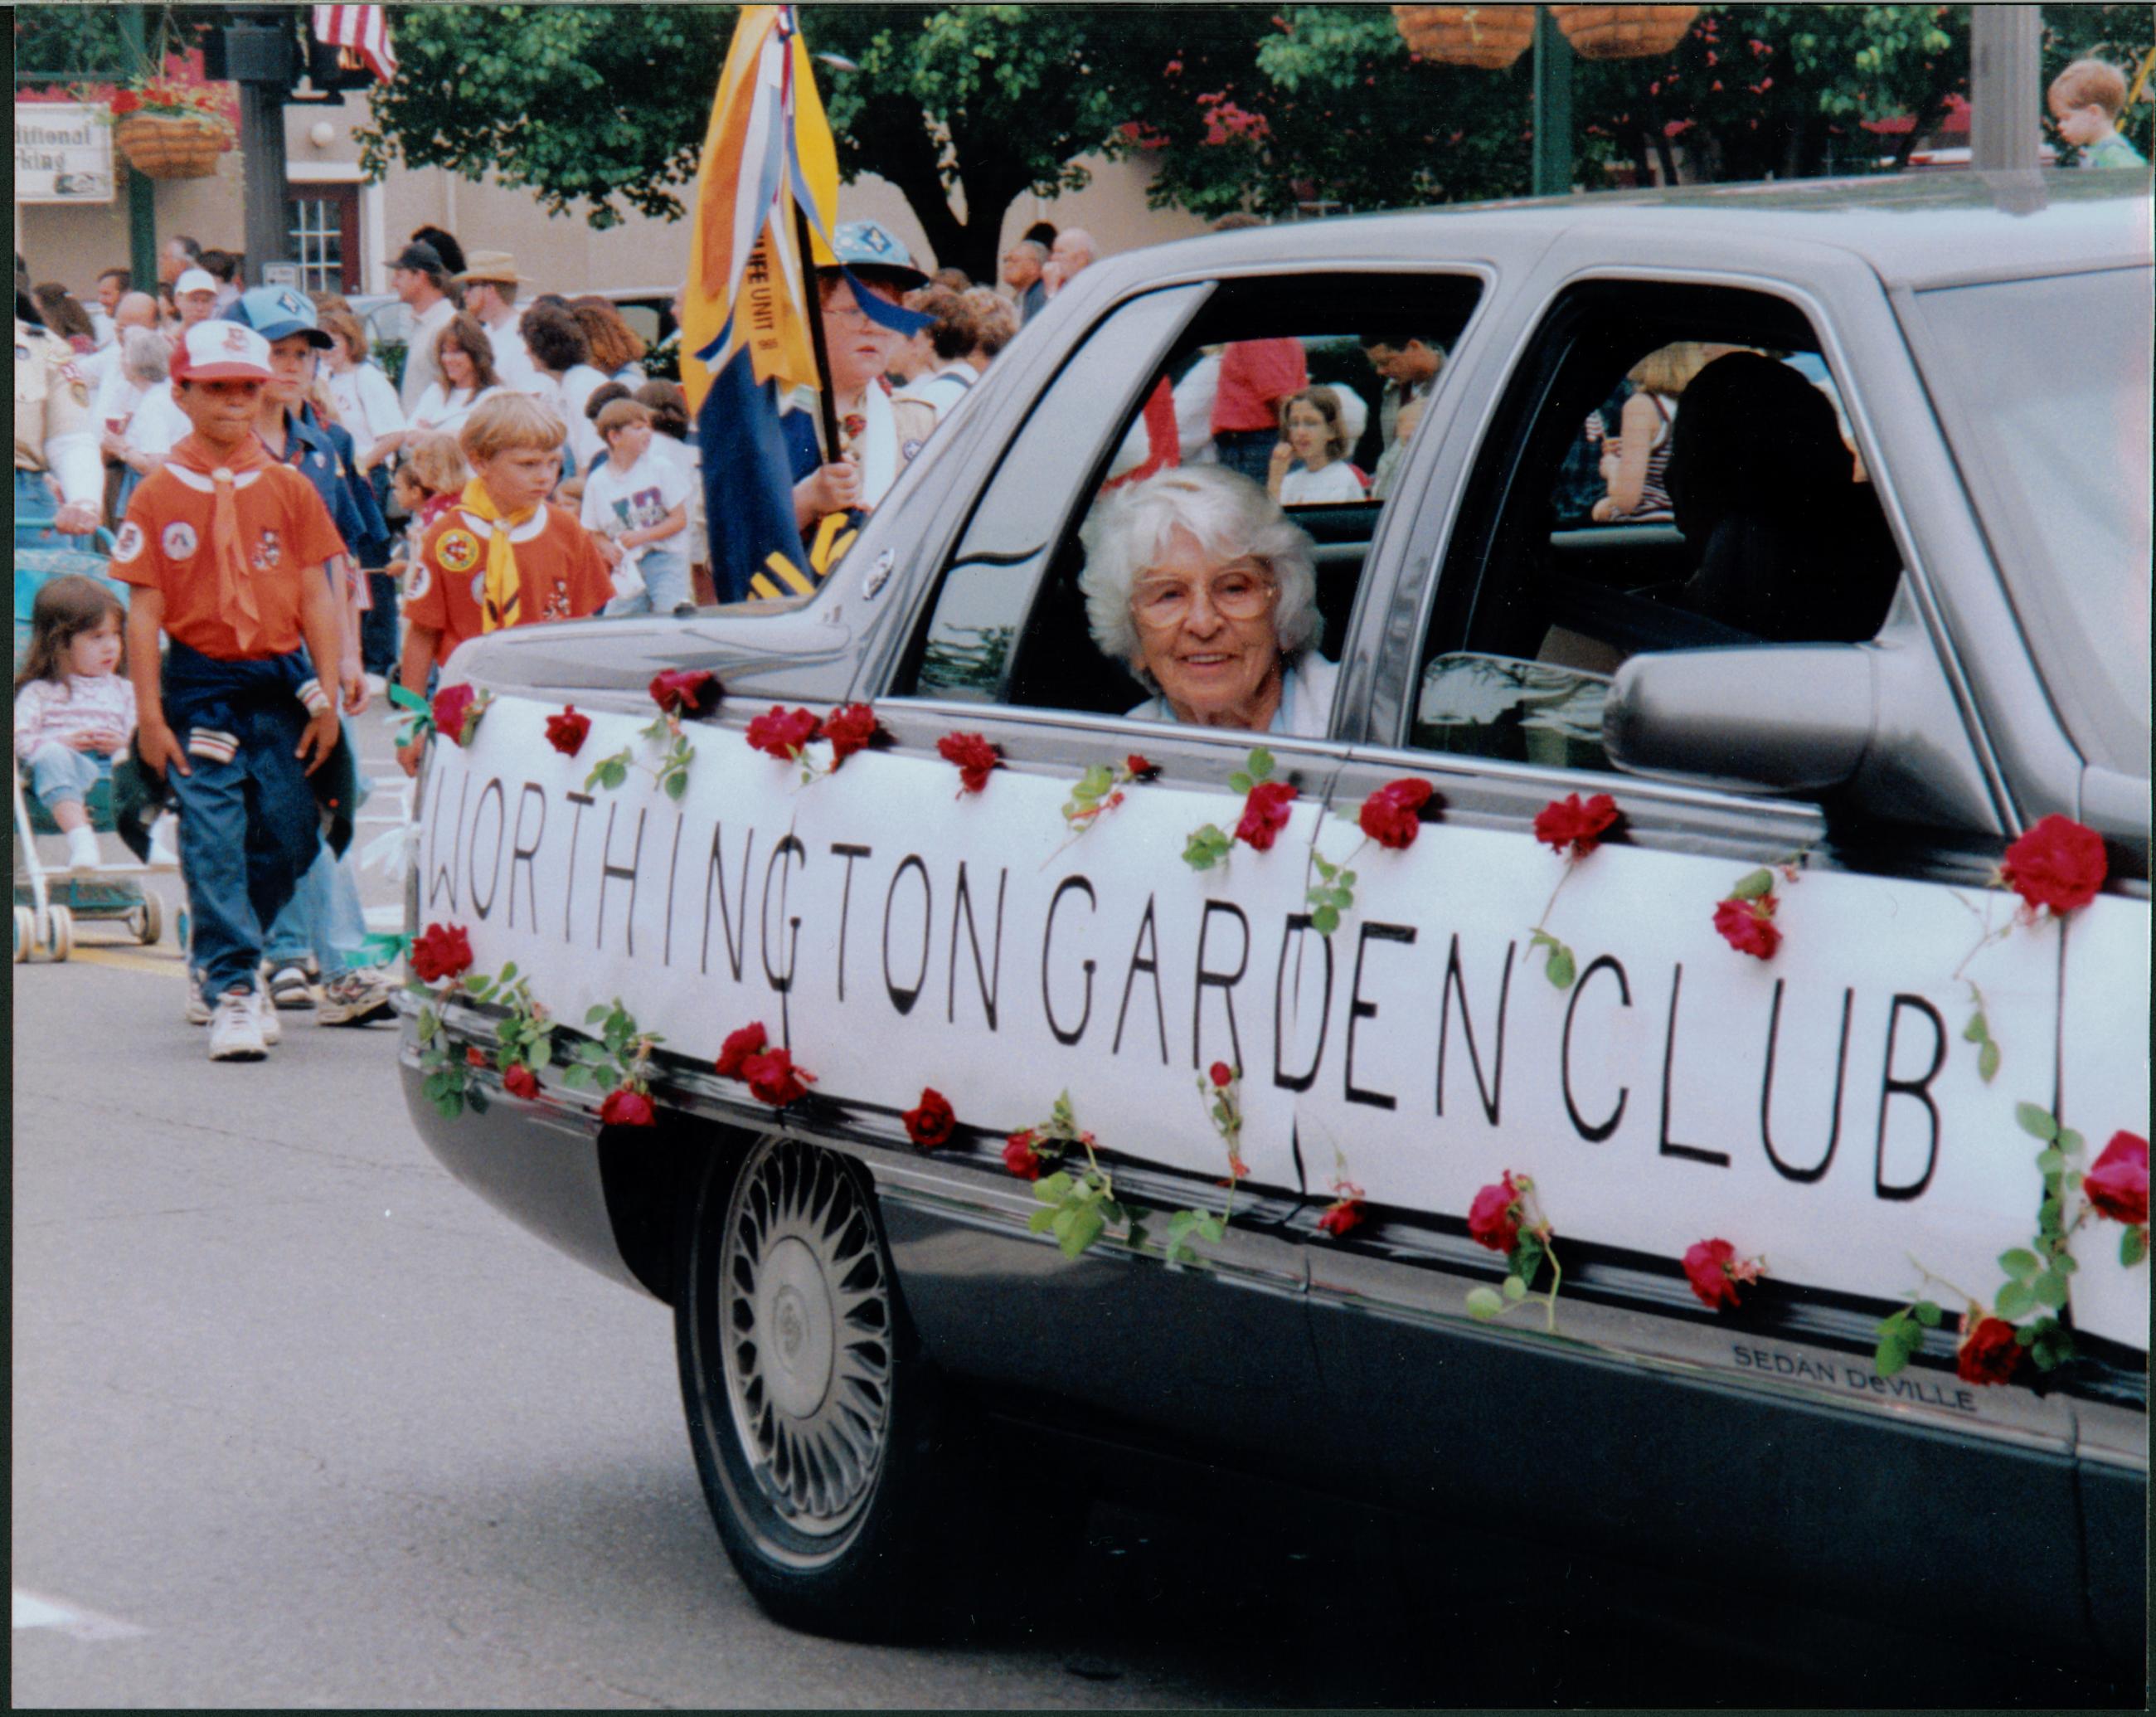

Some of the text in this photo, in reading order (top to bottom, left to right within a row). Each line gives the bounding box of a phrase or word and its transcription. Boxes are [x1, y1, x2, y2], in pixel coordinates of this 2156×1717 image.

[15, 148, 66, 173] king
[750, 288, 774, 330] UNIT
[426, 766, 1947, 1201] WORTHINGTON GARDEN CLUB
[1733, 1345, 1977, 1411] SEDAN DeVILLE
